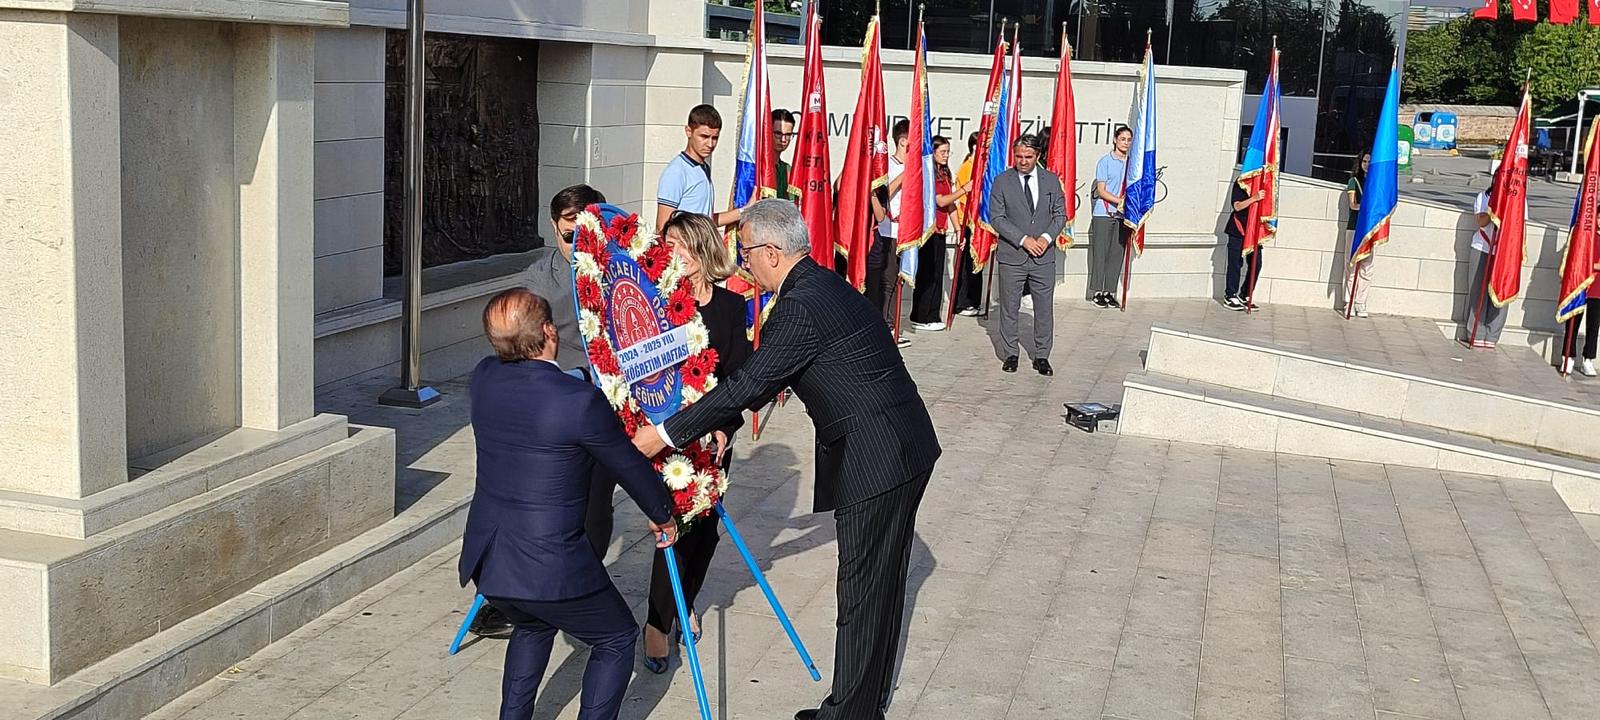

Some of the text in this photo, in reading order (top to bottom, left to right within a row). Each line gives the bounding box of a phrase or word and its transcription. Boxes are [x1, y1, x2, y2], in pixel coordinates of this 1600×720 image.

[1584, 171, 1597, 232] FORD OTOSAN
[619, 348, 639, 363] 2024
[661, 333, 675, 346] YILI
[661, 343, 689, 366] HAFTASI
[635, 385, 666, 407] EĞİTİM
